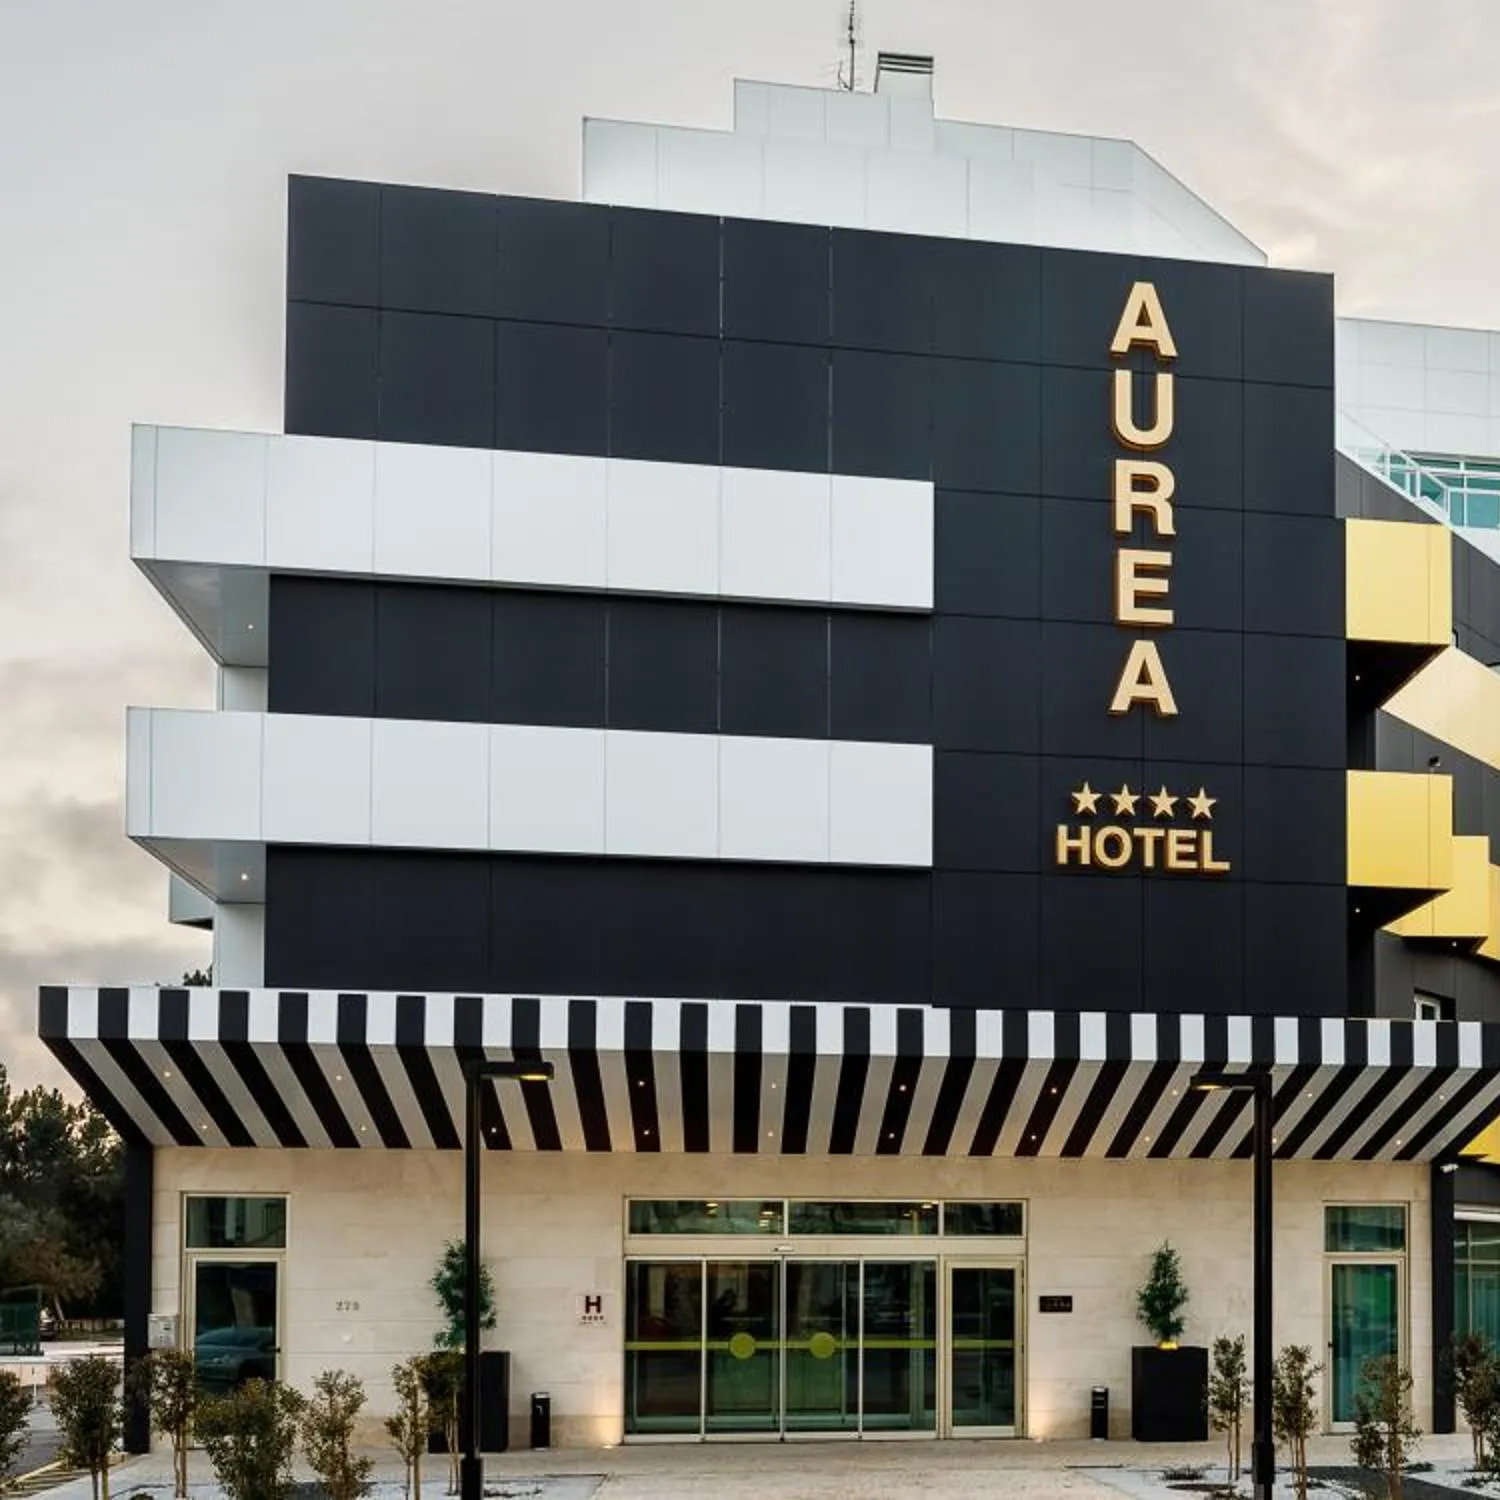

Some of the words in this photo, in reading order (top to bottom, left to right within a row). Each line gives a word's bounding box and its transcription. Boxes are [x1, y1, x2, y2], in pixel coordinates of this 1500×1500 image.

[1109, 281, 1179, 715] AUREA
[1056, 824, 1231, 873] HOTEL
[585, 1295, 602, 1314] H
